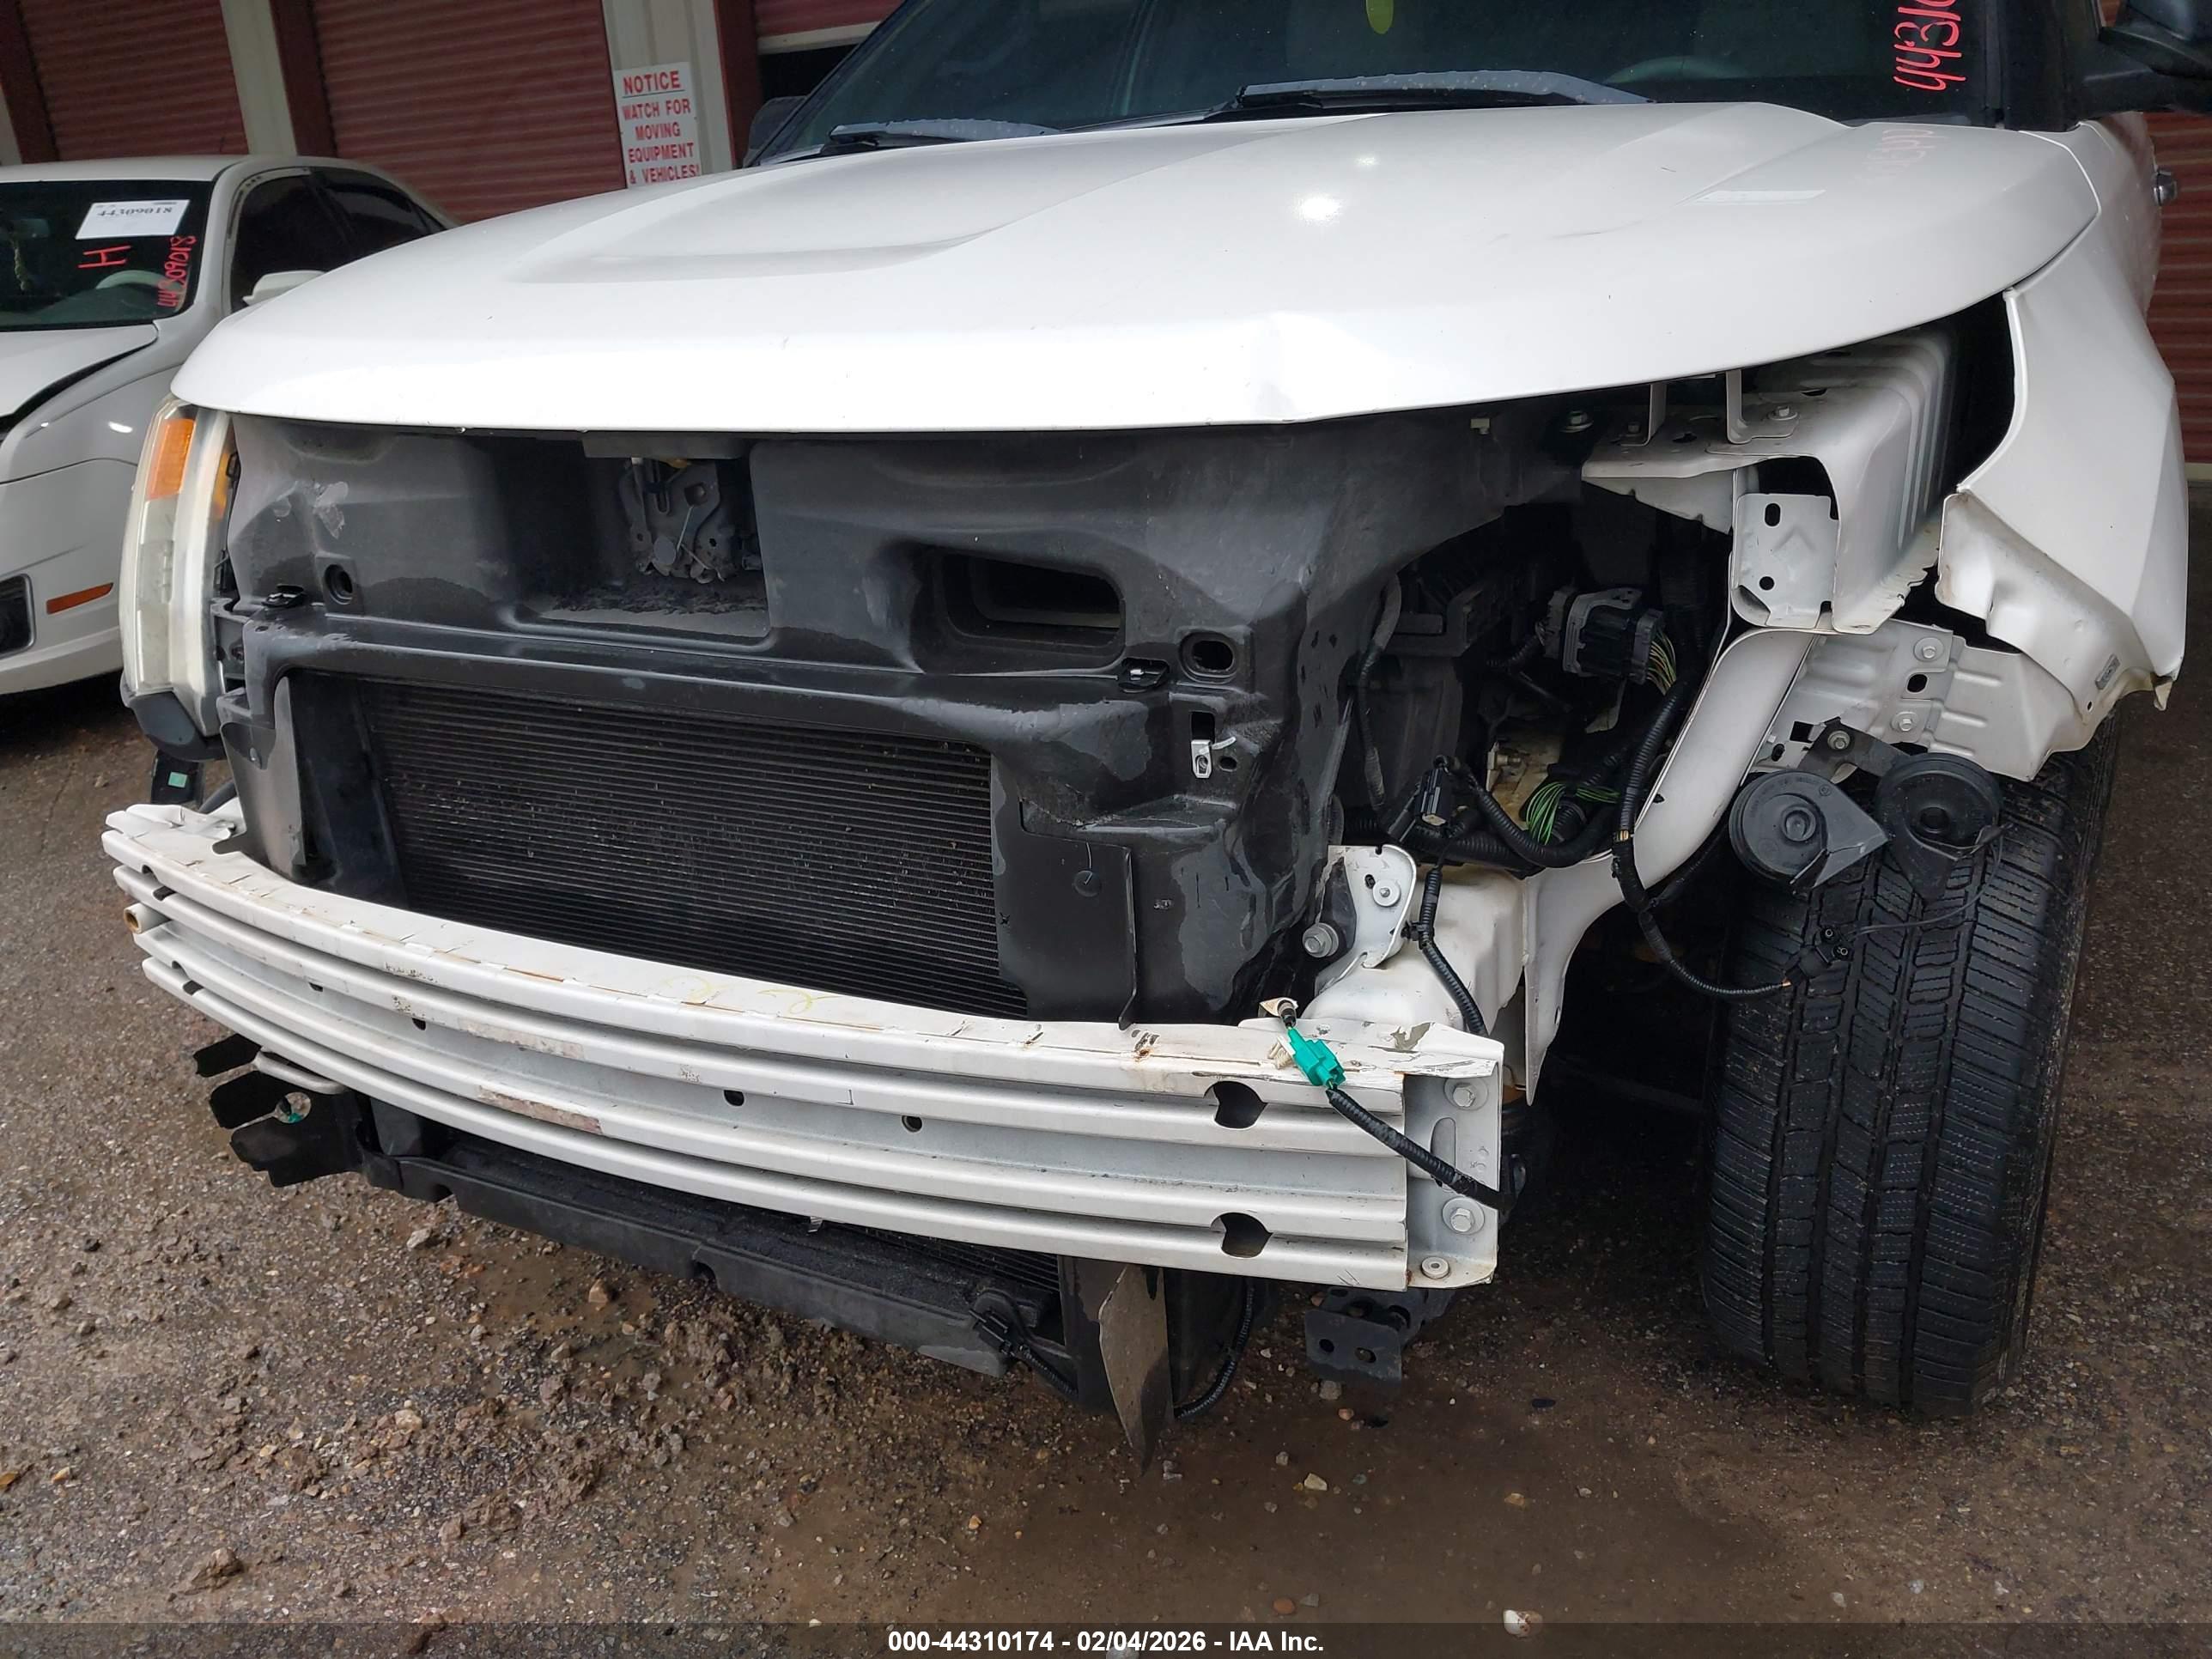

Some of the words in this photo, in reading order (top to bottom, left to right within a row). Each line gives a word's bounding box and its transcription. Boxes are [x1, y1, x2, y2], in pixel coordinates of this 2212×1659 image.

[623, 70, 681, 94] NOTICE
[622, 101, 660, 121] WATCH
[665, 98, 691, 116] FOR
[635, 122, 681, 141] MOVING
[629, 142, 695, 163] EQUIPMENT
[629, 169, 637, 184] &
